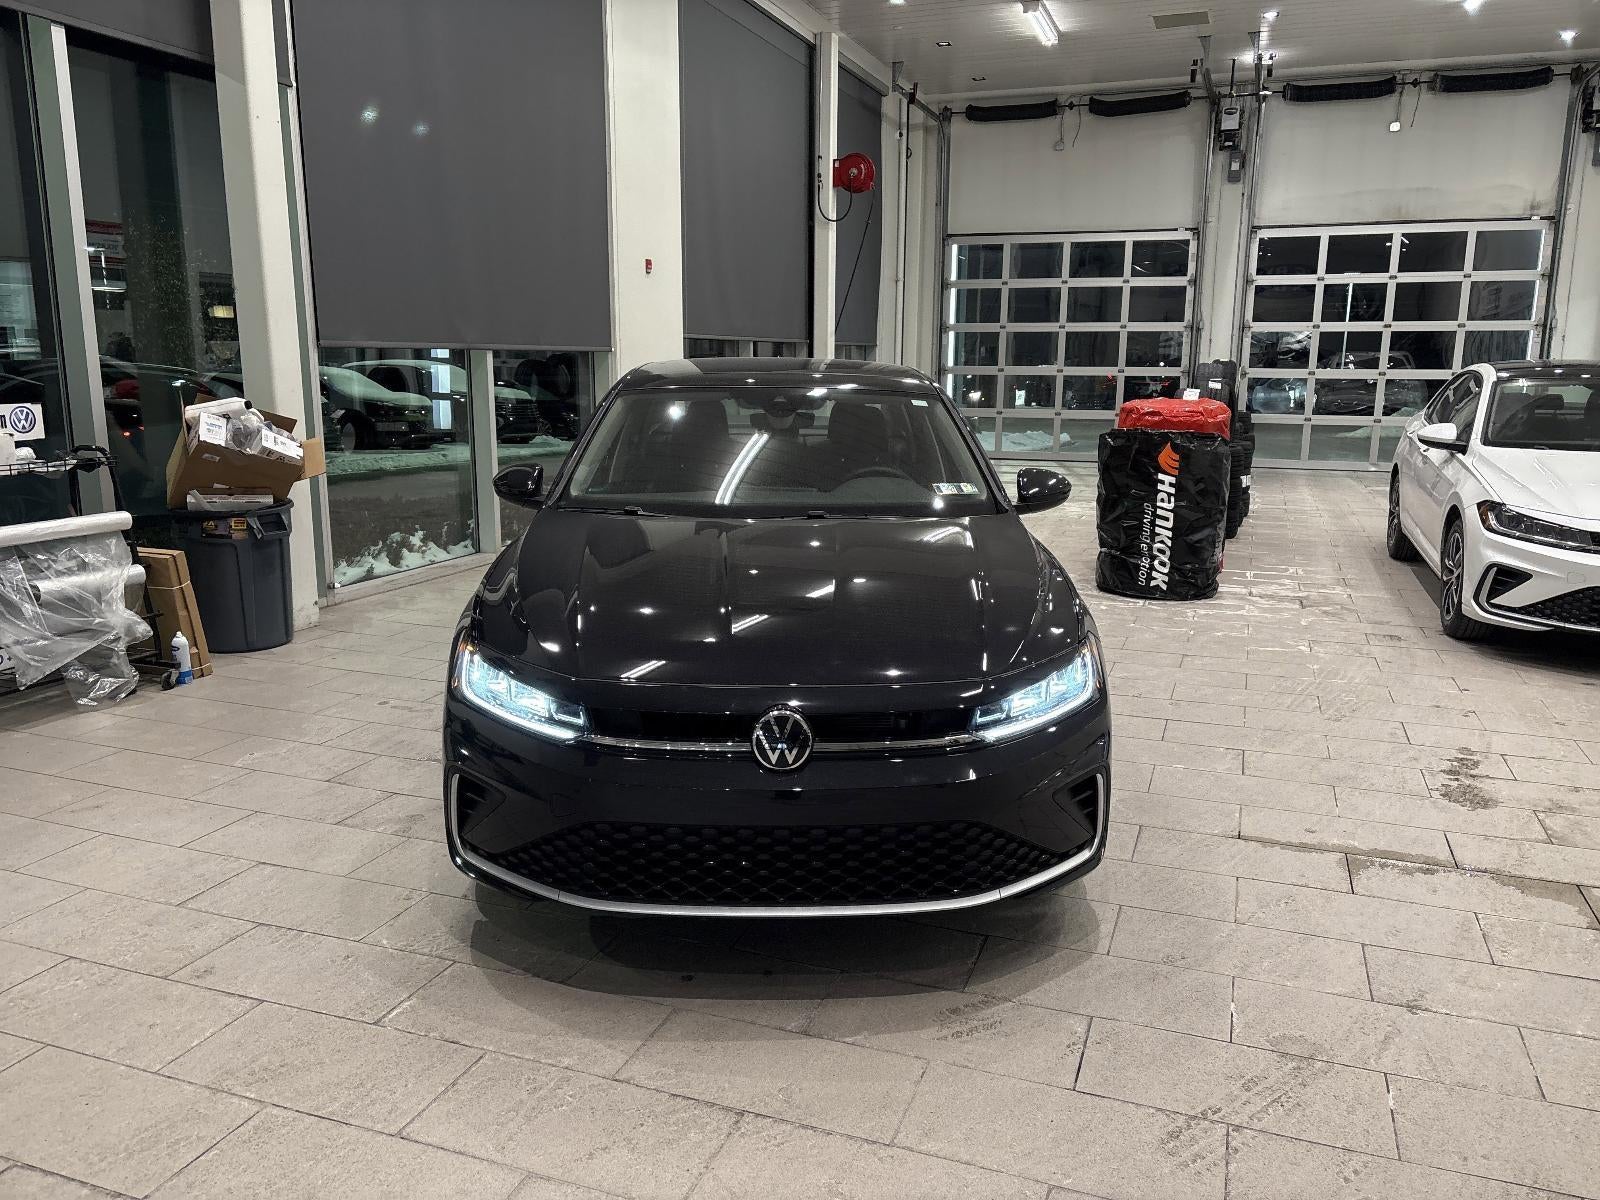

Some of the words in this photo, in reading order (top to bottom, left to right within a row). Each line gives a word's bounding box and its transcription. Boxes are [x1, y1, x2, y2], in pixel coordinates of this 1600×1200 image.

[9, 405, 37, 434] VW
[1139, 502, 1155, 543] driving
[752, 710, 813, 770] VW
